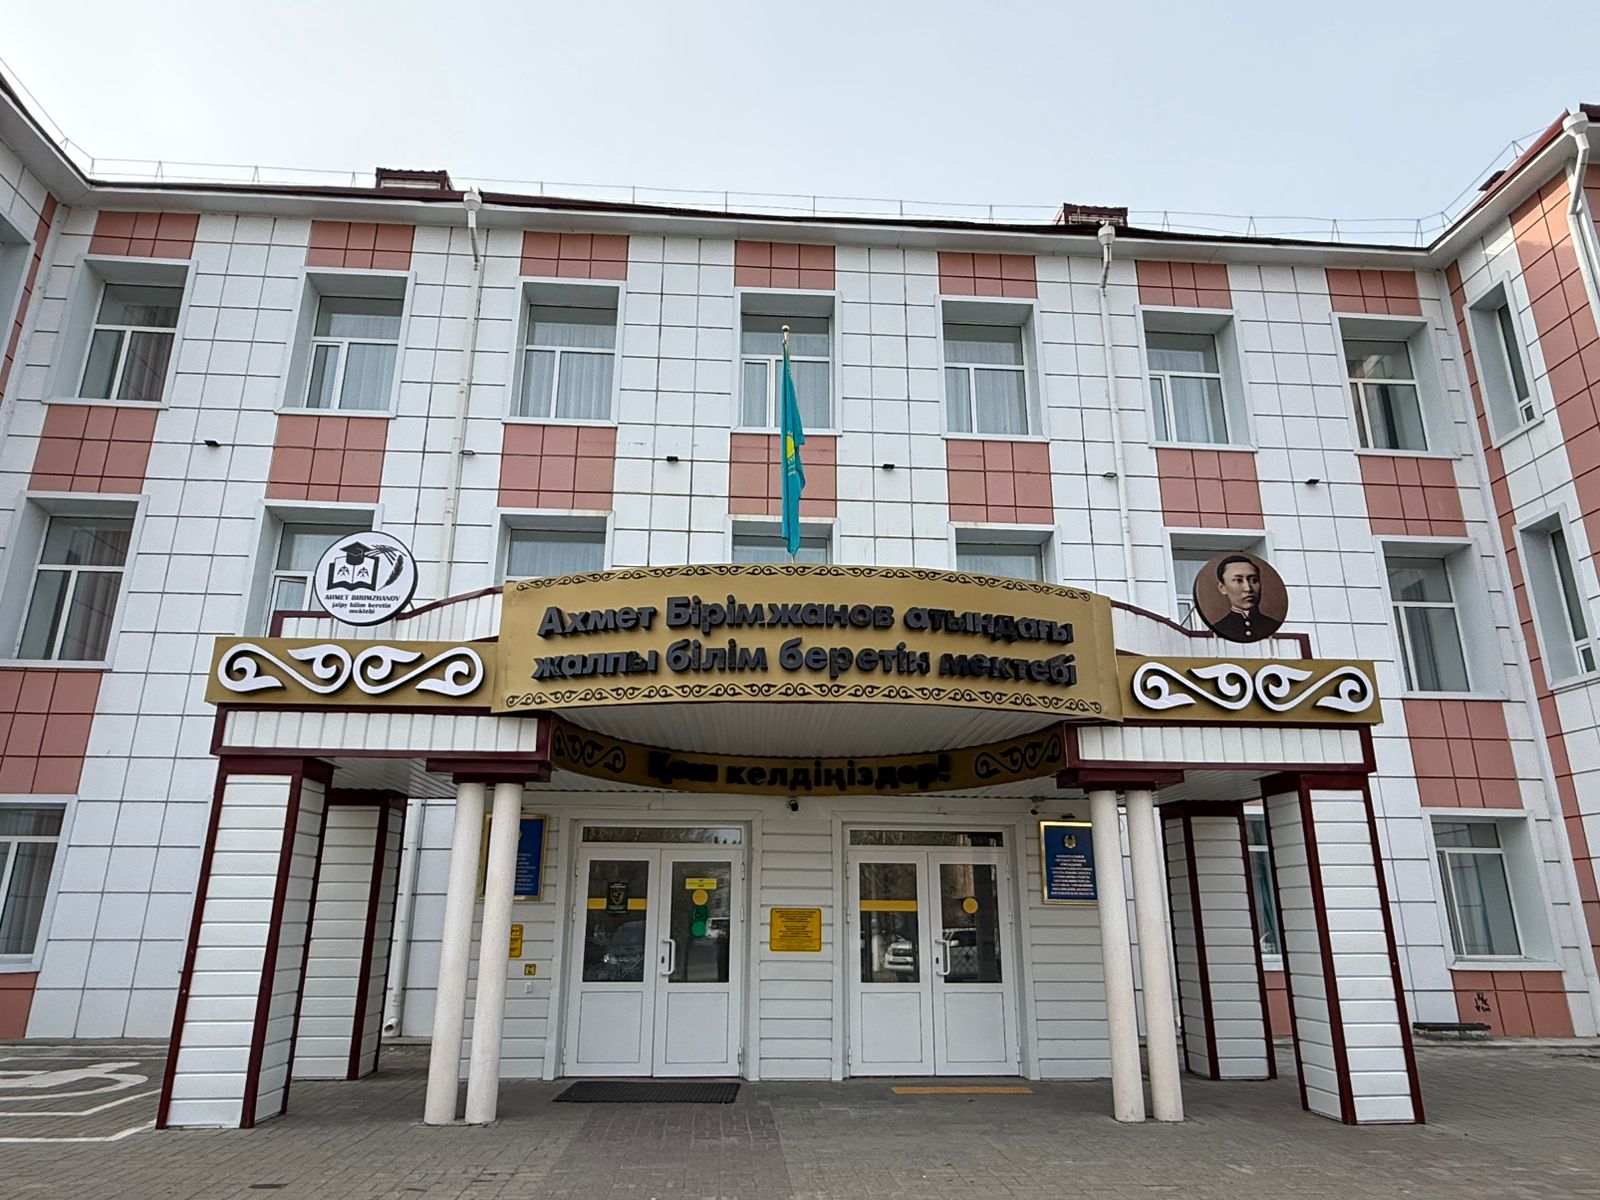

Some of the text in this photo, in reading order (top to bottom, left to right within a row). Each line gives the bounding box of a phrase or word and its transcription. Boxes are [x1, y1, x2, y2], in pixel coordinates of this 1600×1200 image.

[537, 594, 1075, 645] Ахмет Бірімжанов атындағы
[531, 636, 1078, 687] жалпы білім беретін мектебі
